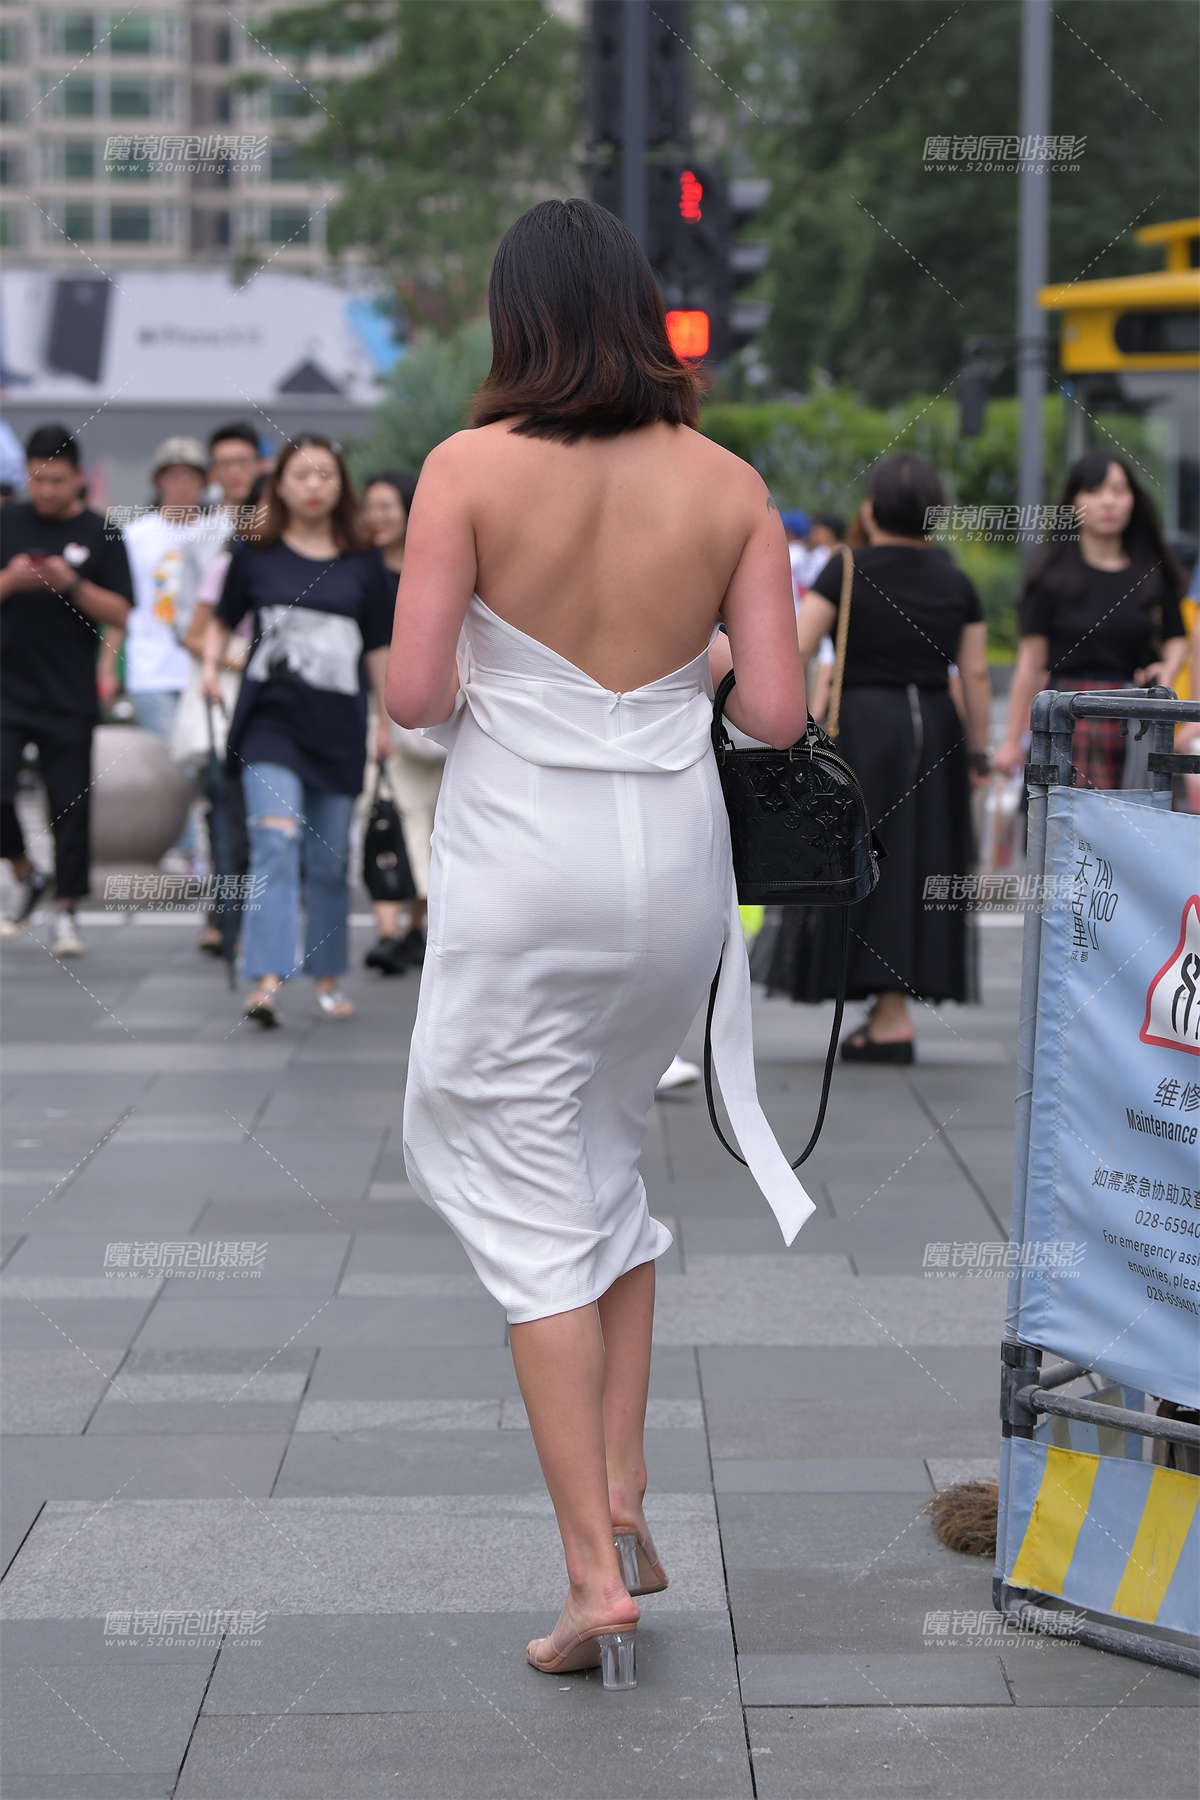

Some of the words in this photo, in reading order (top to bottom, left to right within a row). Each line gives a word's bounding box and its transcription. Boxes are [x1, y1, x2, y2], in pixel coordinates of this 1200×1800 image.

[1093, 857, 1113, 889] TAI
[1088, 889, 1119, 922] KOO
[1153, 1077, 1200, 1112] 维修
[1126, 1107, 1198, 1145] Maintenance
[1103, 1229, 1117, 1245] For
[1119, 1236, 1177, 1263] emergency
[1128, 1261, 1171, 1287] enquiries,
[1147, 1285, 1200, 1316] 028-659401
